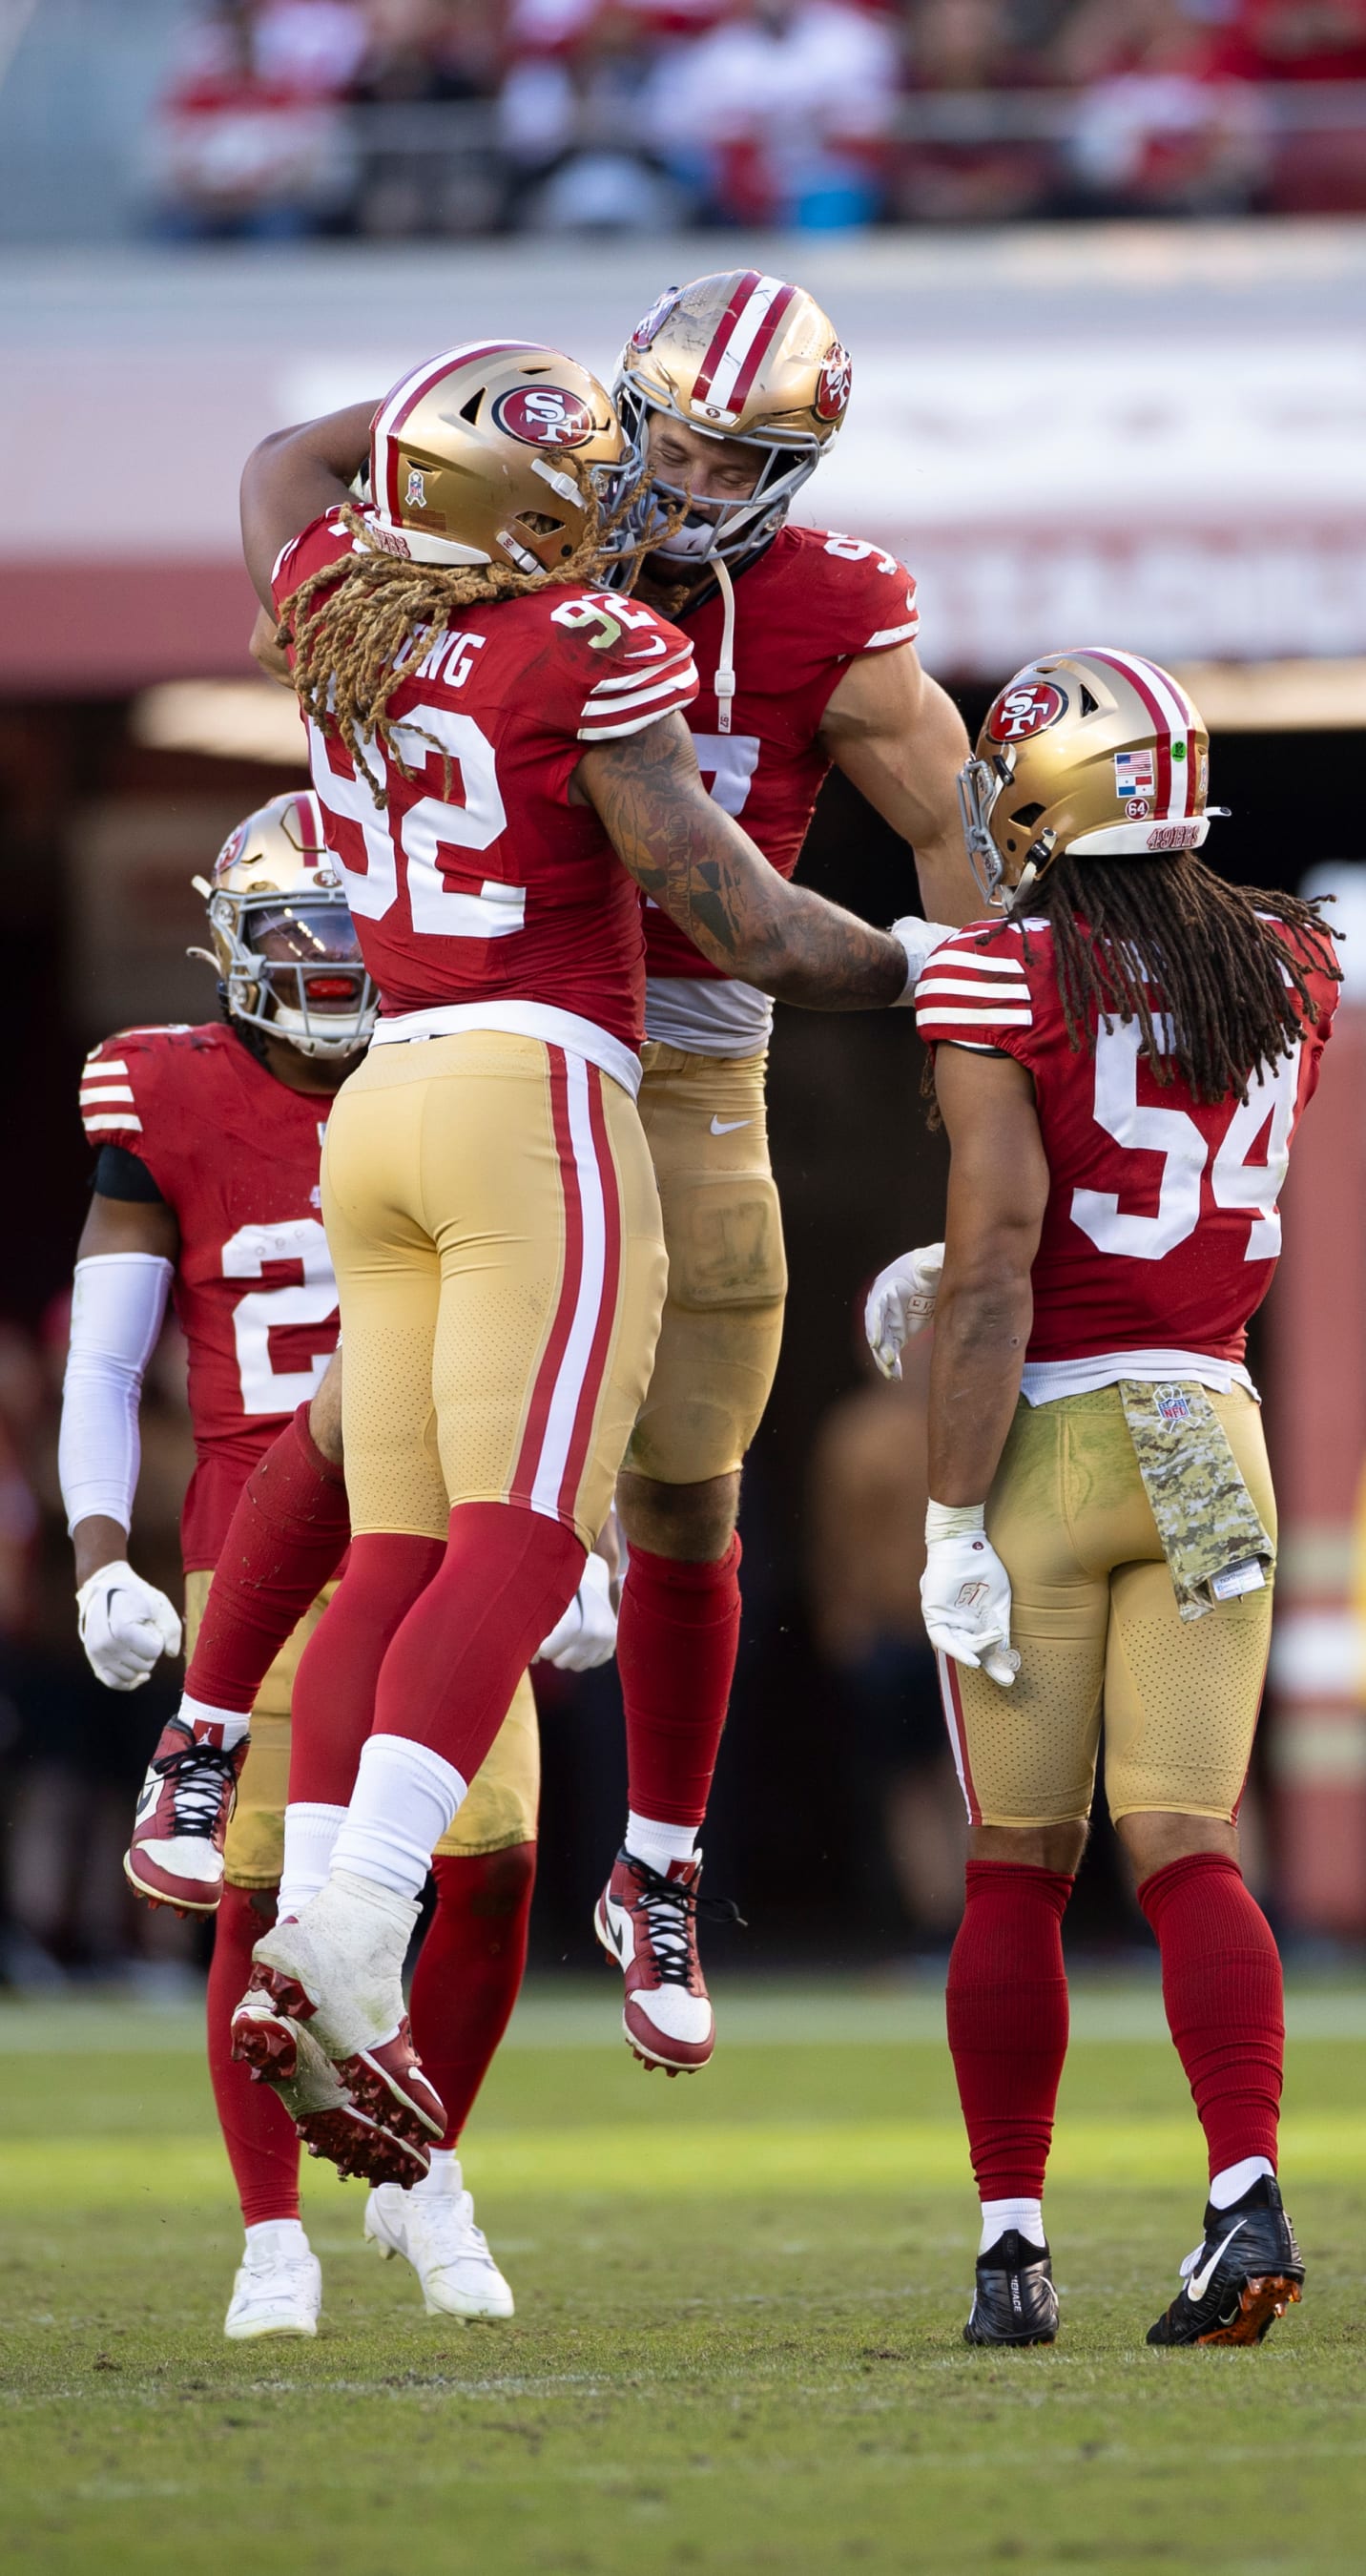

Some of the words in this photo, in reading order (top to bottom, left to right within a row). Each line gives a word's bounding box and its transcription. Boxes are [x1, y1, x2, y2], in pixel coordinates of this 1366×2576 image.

[525, 392, 582, 443] SF
[823, 530, 898, 575] 9
[550, 592, 658, 649] 92
[384, 622, 486, 688] UNG
[1000, 688, 1049, 737] SF
[308, 671, 527, 939] 92
[1128, 801, 1146, 816] 64
[1147, 825, 1200, 850] 49ERS
[1069, 1012, 1302, 1262] 54
[1164, 1406, 1187, 1418] NFL
